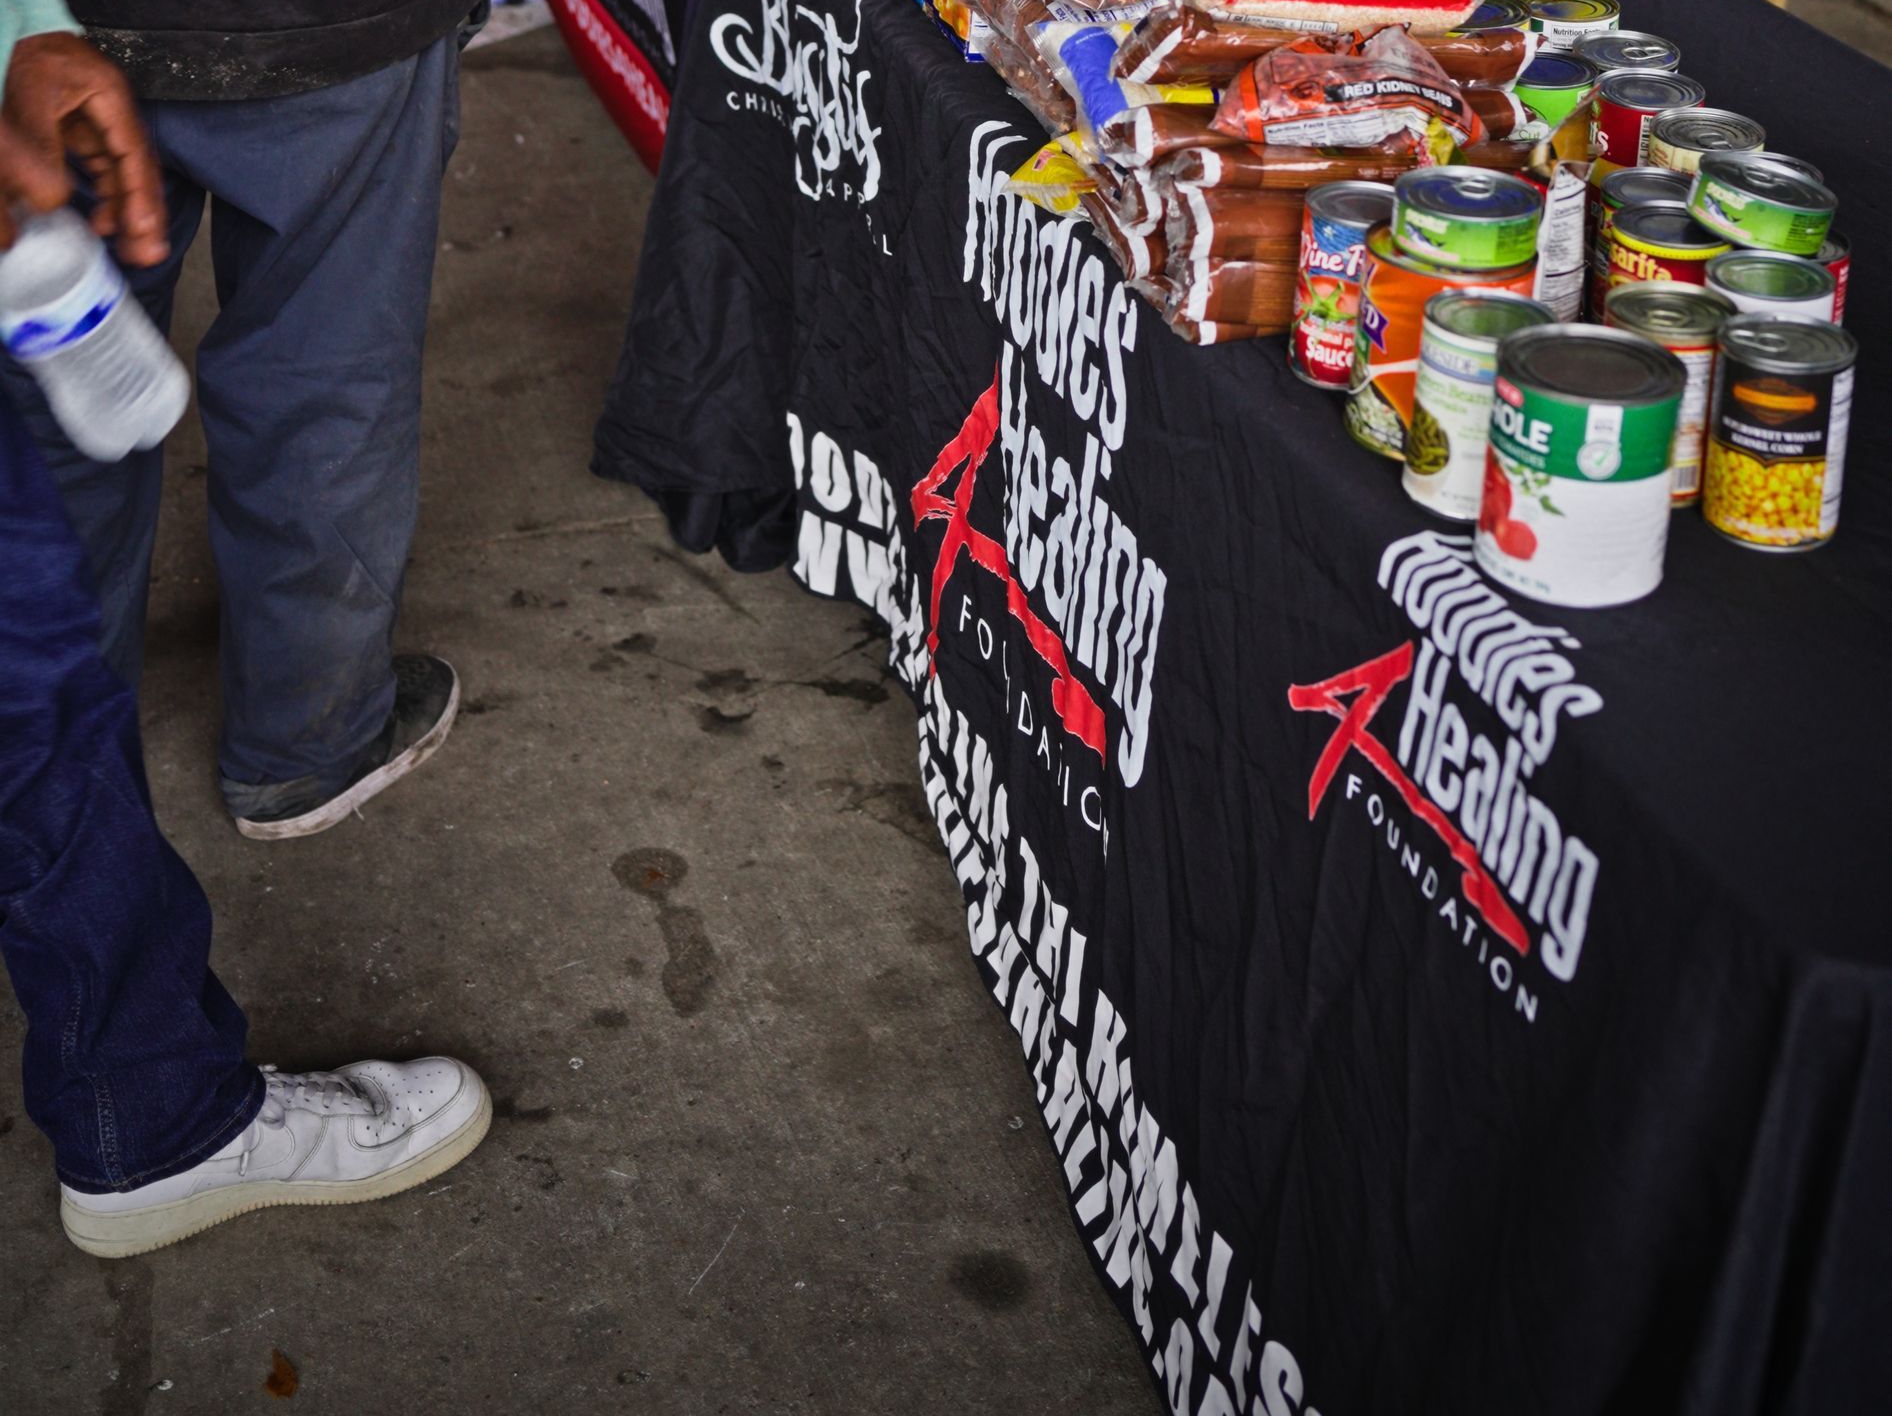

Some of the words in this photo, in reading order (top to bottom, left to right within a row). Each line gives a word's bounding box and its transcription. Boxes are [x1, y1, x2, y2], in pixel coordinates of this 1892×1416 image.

[1553, 28, 1583, 37] Nutrition
[1344, 84, 1374, 98] RED
[1376, 81, 1421, 95] KIDNEY
[1610, 242, 1673, 281] sarita
[1493, 398, 1553, 454] HOLE
[1398, 637, 1600, 982] Healing
[1345, 773, 1538, 1022] FOUNDATION
